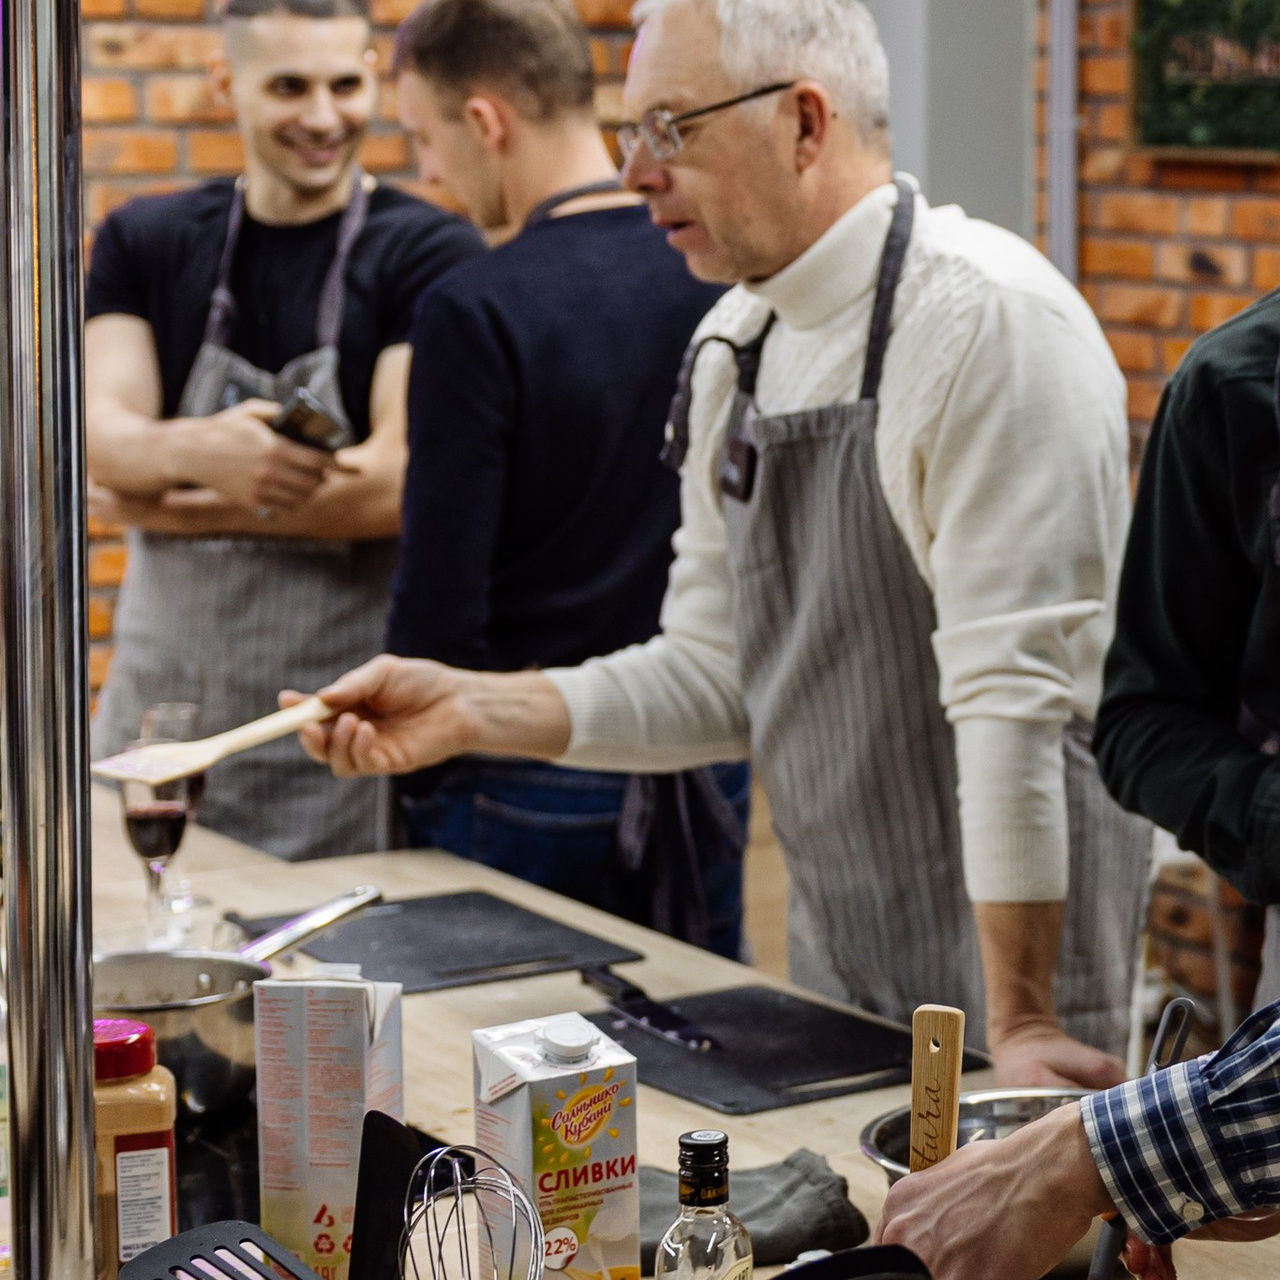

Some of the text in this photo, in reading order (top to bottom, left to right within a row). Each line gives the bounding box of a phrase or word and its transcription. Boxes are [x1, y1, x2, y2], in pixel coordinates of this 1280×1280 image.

[551, 1083, 619, 1131] Солнышко
[564, 1102, 612, 1142] Кубани
[912, 1077, 942, 1167] tura
[538, 1154, 636, 1193] СЛИВКИ
[545, 1236, 576, 1257] 22%
